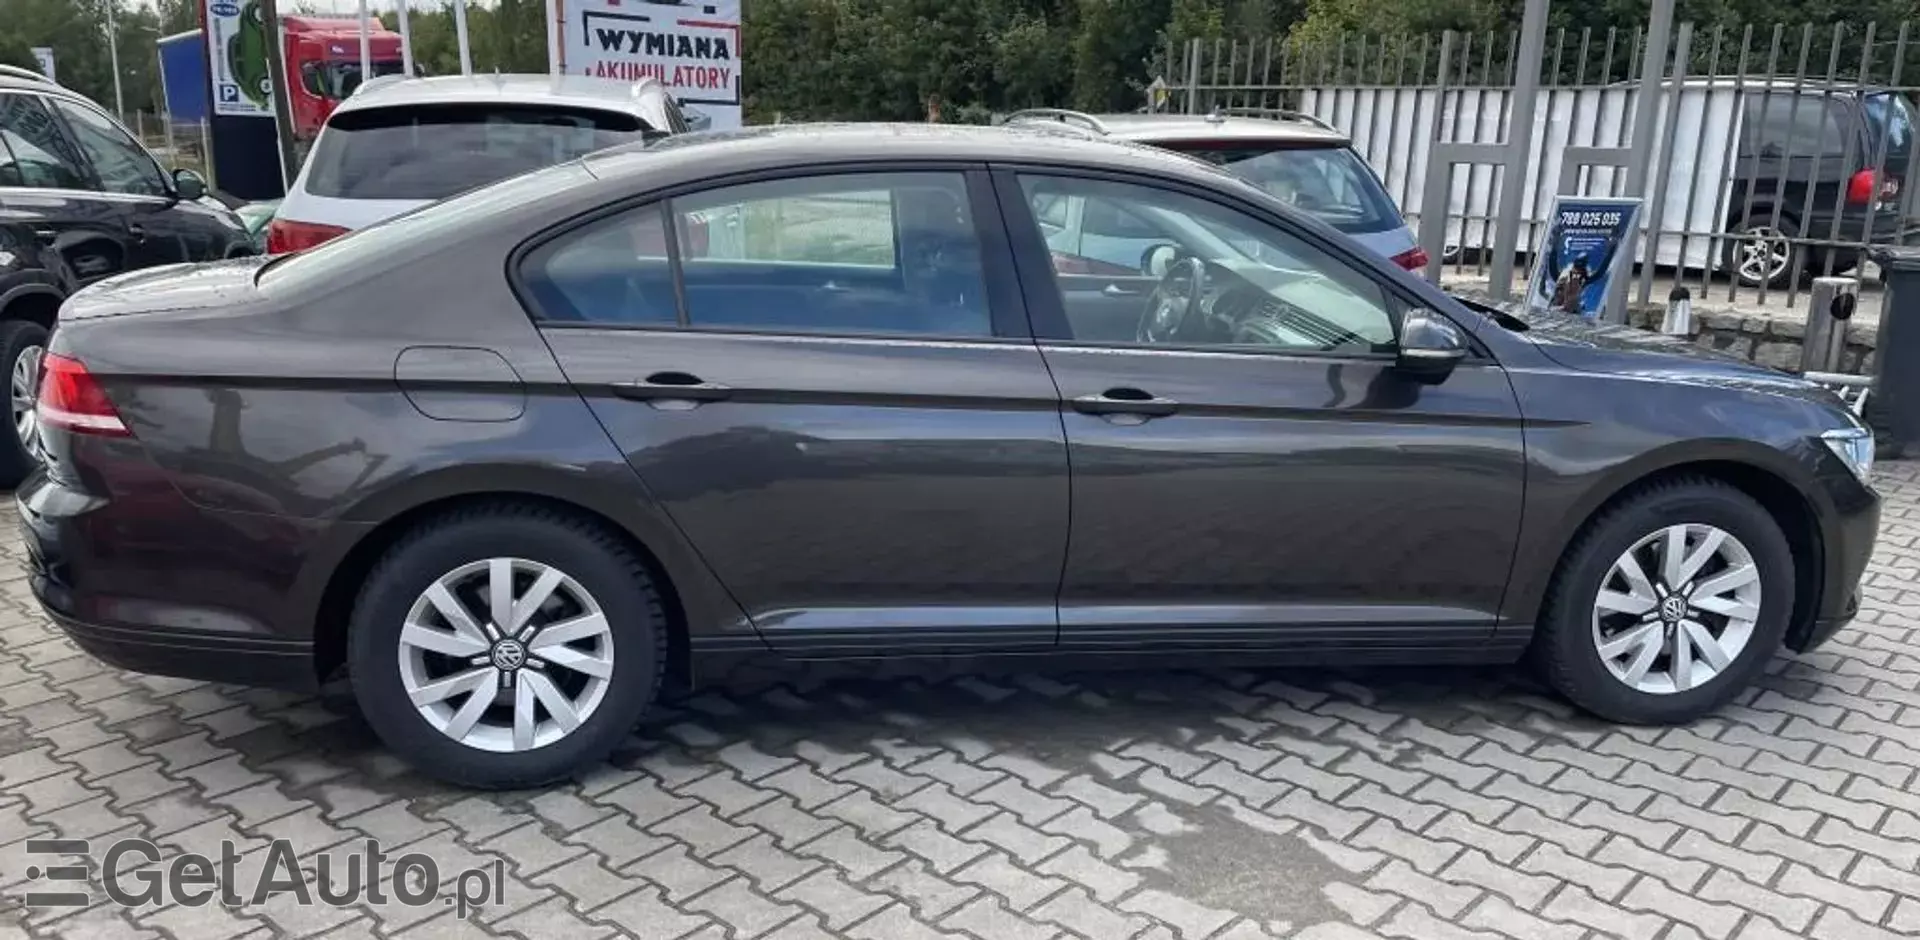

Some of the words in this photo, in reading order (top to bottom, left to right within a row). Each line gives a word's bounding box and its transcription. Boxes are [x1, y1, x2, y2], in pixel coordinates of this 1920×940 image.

[596, 28, 730, 60] WYMIANA
[596, 60, 730, 89] AKUMULATORY
[223, 86, 236, 100] P
